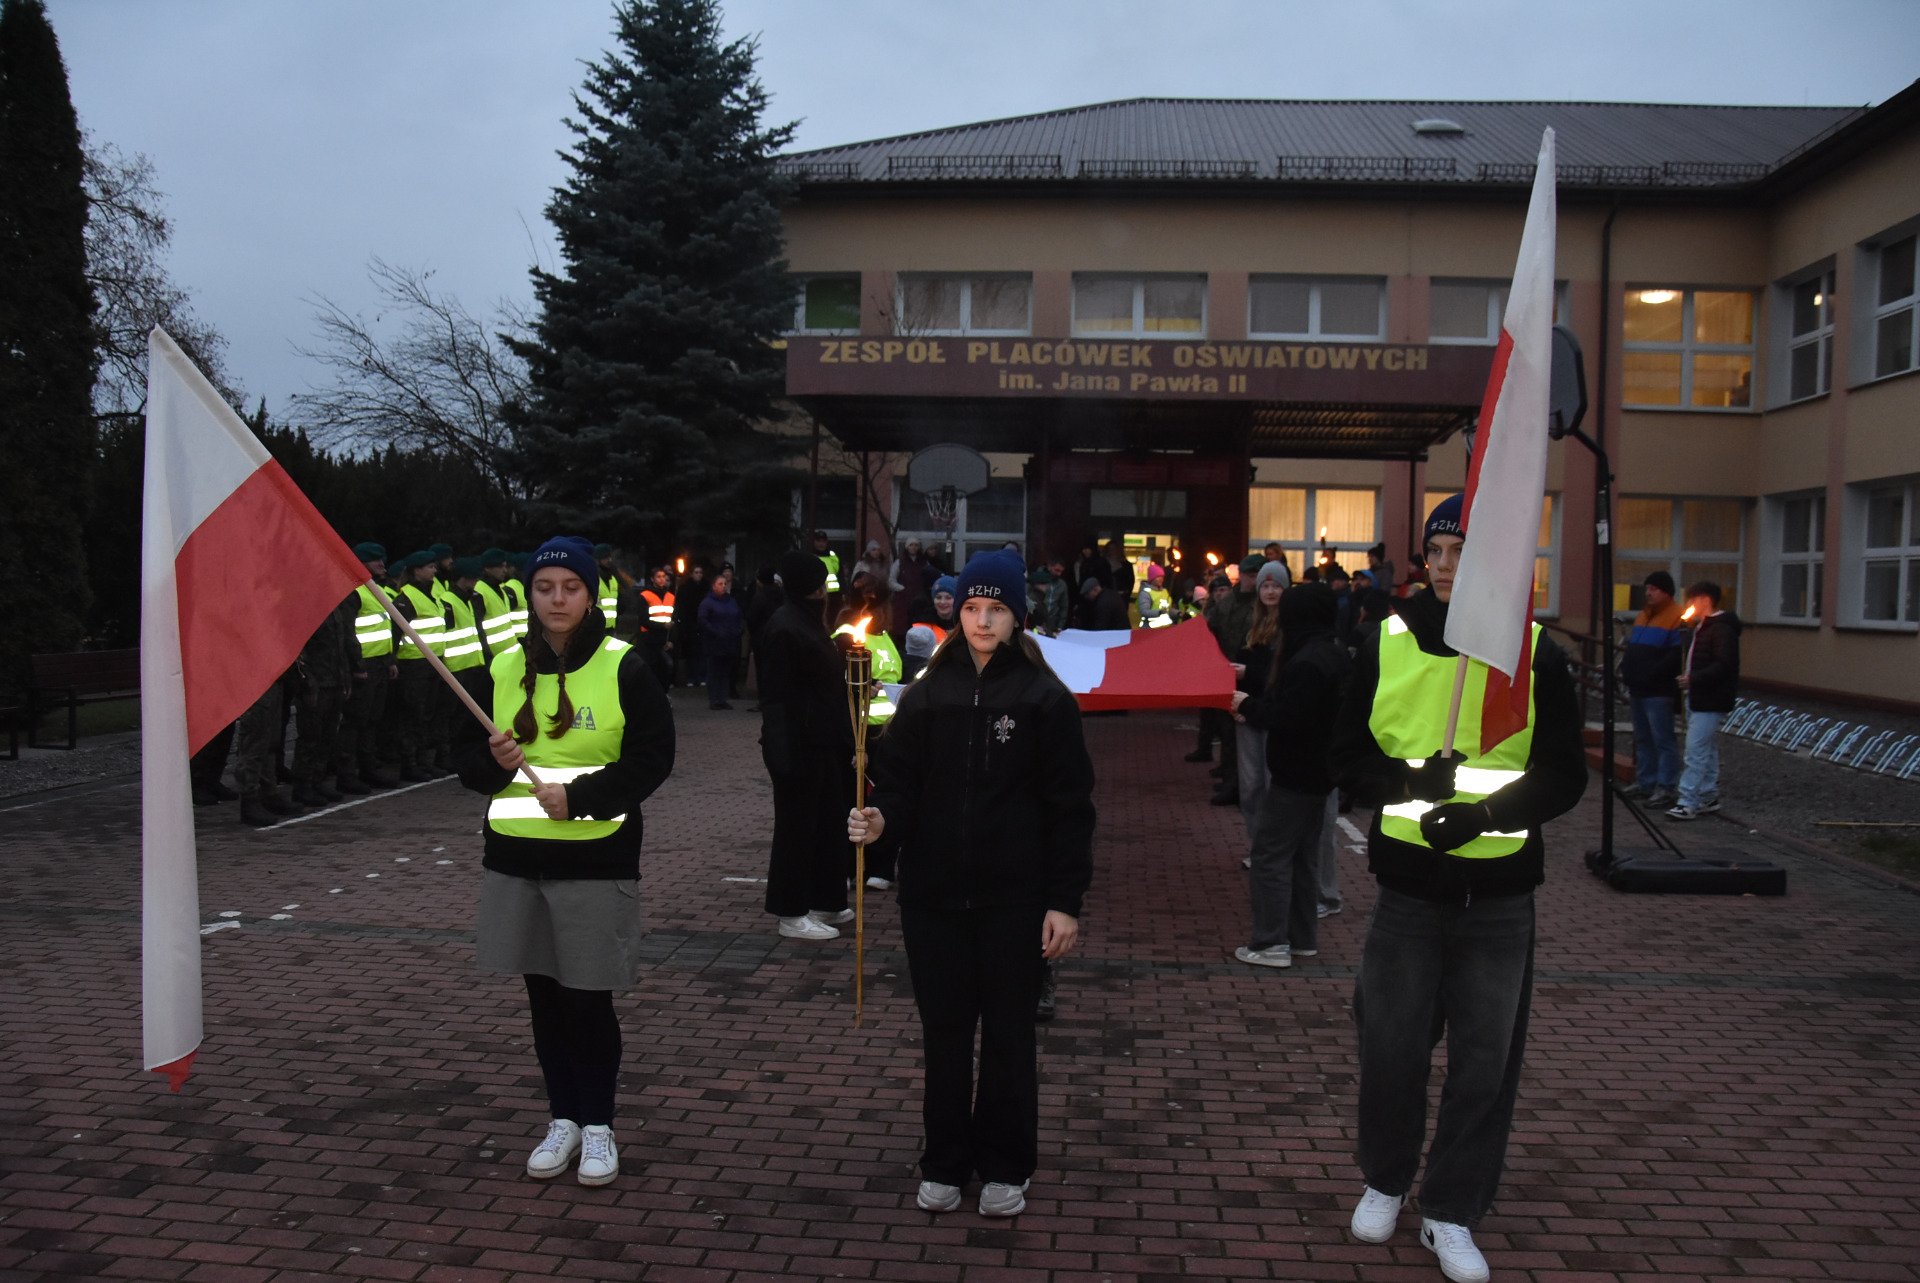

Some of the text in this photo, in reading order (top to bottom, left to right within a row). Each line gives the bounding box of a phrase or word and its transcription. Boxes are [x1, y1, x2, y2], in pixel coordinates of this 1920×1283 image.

[819, 338, 1428, 371] ZESPÓŁ PLACÓWEK OŚWIATOWYCH
[999, 370, 1247, 393] im. Jana Pawła II
[536, 551, 568, 562] #ZHP
[967, 585, 1001, 597] #ZHP
